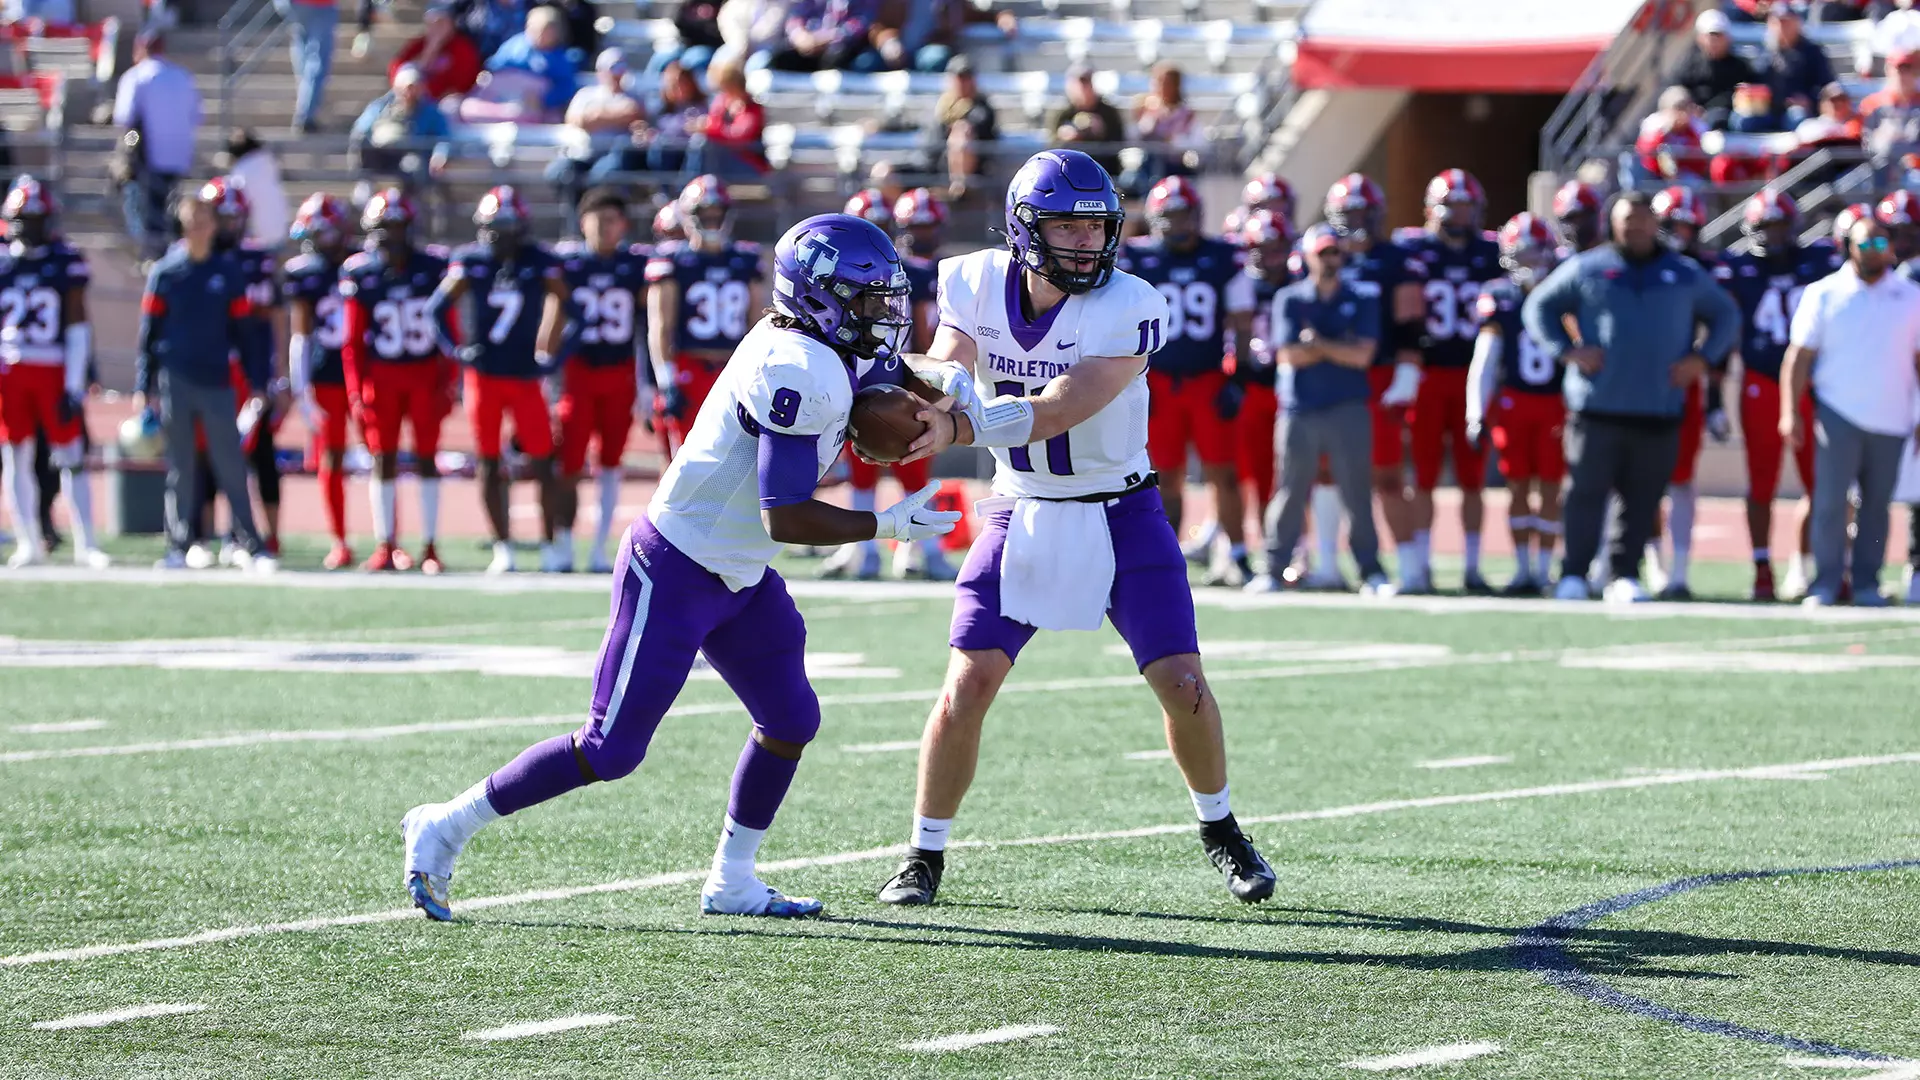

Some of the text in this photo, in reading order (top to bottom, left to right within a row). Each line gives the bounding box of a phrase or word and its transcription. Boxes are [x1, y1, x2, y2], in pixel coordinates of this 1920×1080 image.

[373, 299, 438, 358] 35
[488, 290, 524, 343] 7
[573, 287, 635, 343] 29
[685, 282, 748, 340] 38
[977, 326, 1000, 339] WAC
[1133, 318, 1160, 355] 11
[988, 353, 1070, 379] TARLETON
[768, 387, 802, 428] 9
[633, 543, 651, 567] TEXANS
